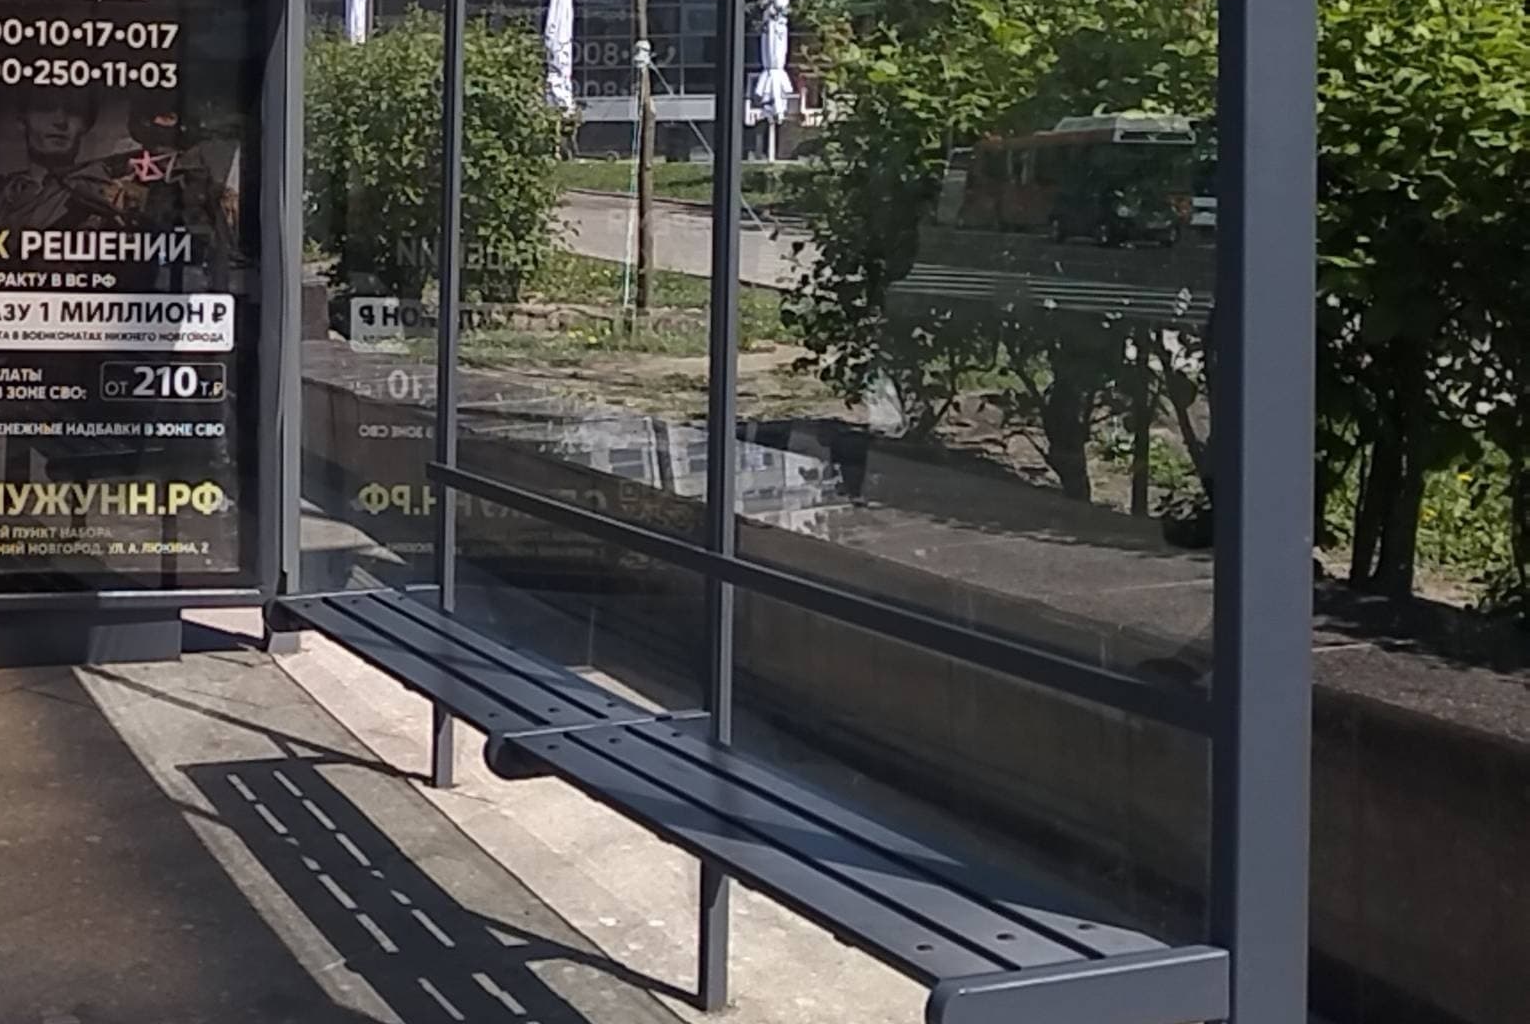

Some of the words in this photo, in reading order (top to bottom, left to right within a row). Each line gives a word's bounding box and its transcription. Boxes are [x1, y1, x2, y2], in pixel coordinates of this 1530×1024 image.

[20, 227, 192, 263] РЕШЕНИЙ
[51, 273, 62, 288] В
[66, 274, 88, 288] ВС
[92, 274, 117, 289] РФ
[39, 301, 49, 322] 1
[61, 301, 203, 324] МИЛЛИОН
[12, 331, 19, 340] В
[21, 331, 102, 341] ВОЕНКОМАТАХ
[104, 332, 157, 342] НИЖНЕГО
[159, 333, 225, 343] НОВГОРОДА
[105, 381, 130, 396] ОТ
[132, 366, 198, 398] 210
[7, 387, 47, 400] ЗОНЕ
[49, 387, 87, 401] СВО:
[66, 423, 141, 437] НАДБАВКИ
[144, 423, 154, 436] В
[155, 423, 193, 436] ЗОНЕ
[195, 423, 225, 437] СВО
[12, 527, 58, 538] ПУНКТ
[60, 527, 112, 538] НАБОРА
